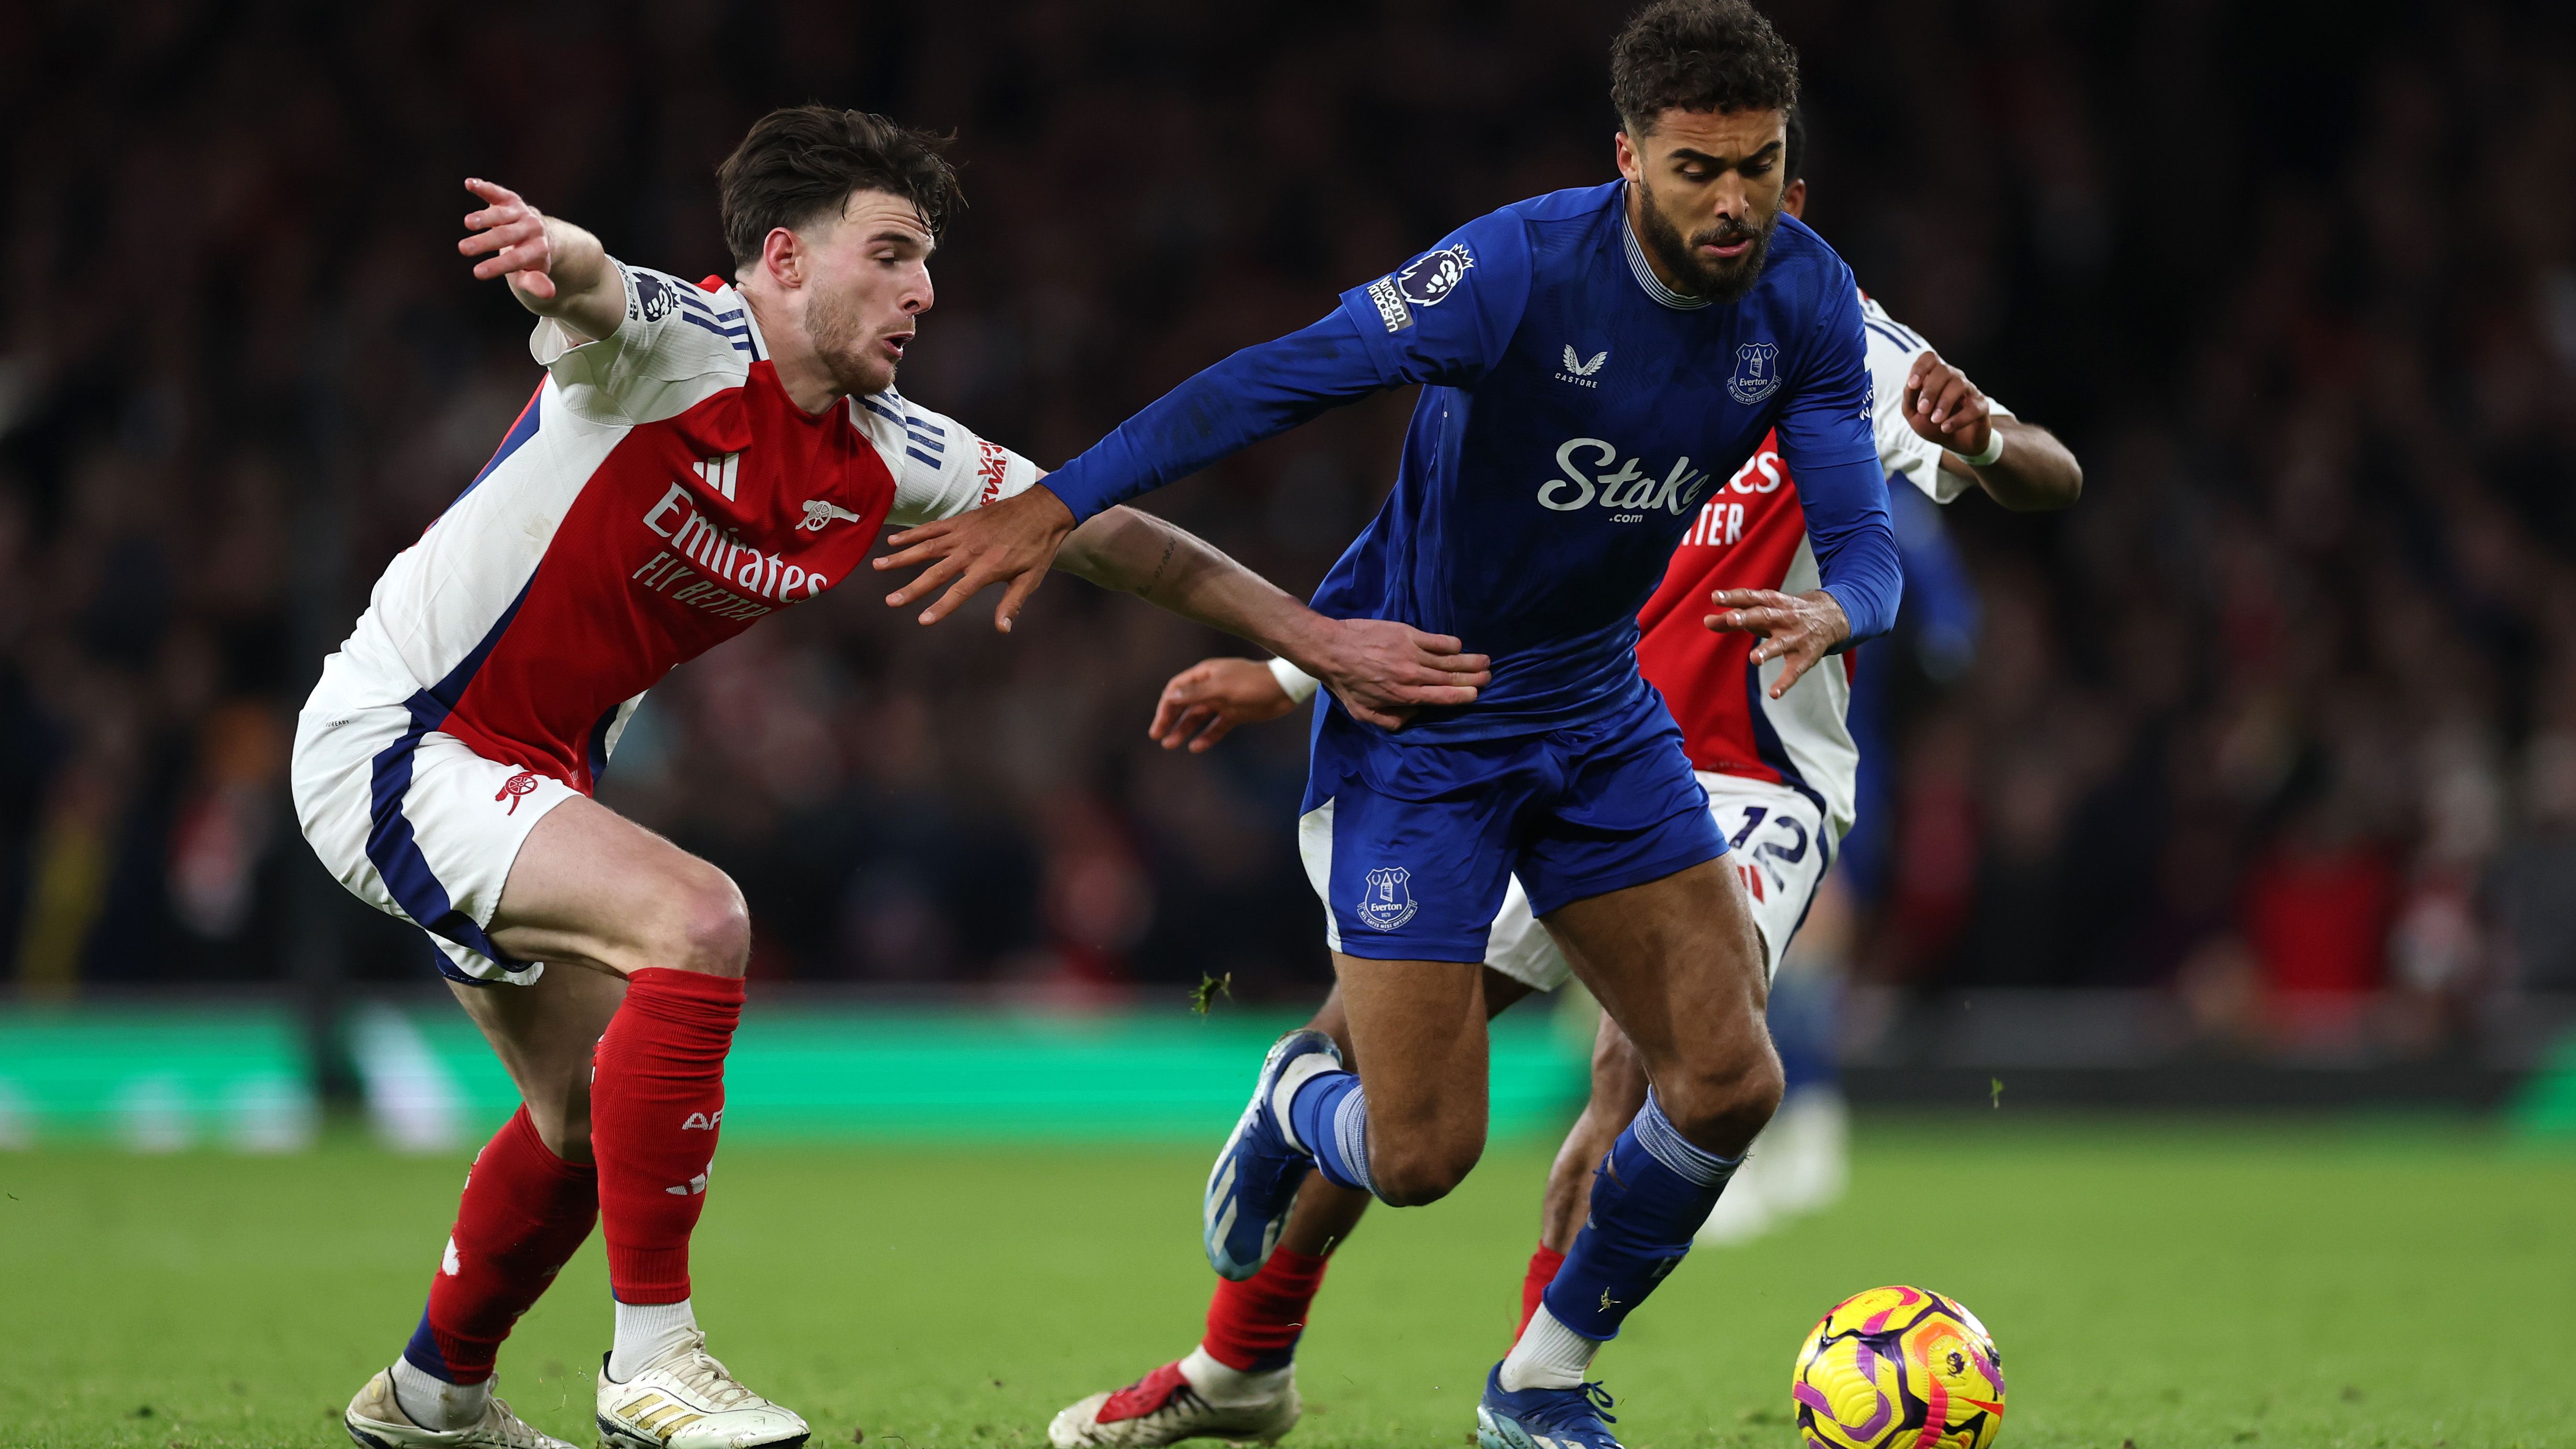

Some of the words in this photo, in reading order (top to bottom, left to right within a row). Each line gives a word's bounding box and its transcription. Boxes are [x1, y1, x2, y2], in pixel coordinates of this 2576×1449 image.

[1378, 275, 1392, 290] No
[1372, 291, 1398, 333] racism
[1383, 286, 1407, 322] room
[1555, 372, 1597, 388] CASTORE
[1740, 378, 1767, 386] Everton
[1756, 384, 1777, 401] OPTIMUM
[1537, 438, 1710, 516] Stake
[1716, 451, 1781, 495] es
[1609, 513, 1643, 523] .com
[643, 481, 828, 604] Emirates
[632, 551, 695, 592] FLY
[672, 580, 773, 622] BETTER
[1729, 806, 1807, 894] 12
[1367, 918, 1379, 928] SATIS
[1393, 909, 1414, 927] OPTIMUM
[1371, 903, 1402, 912] Everton
